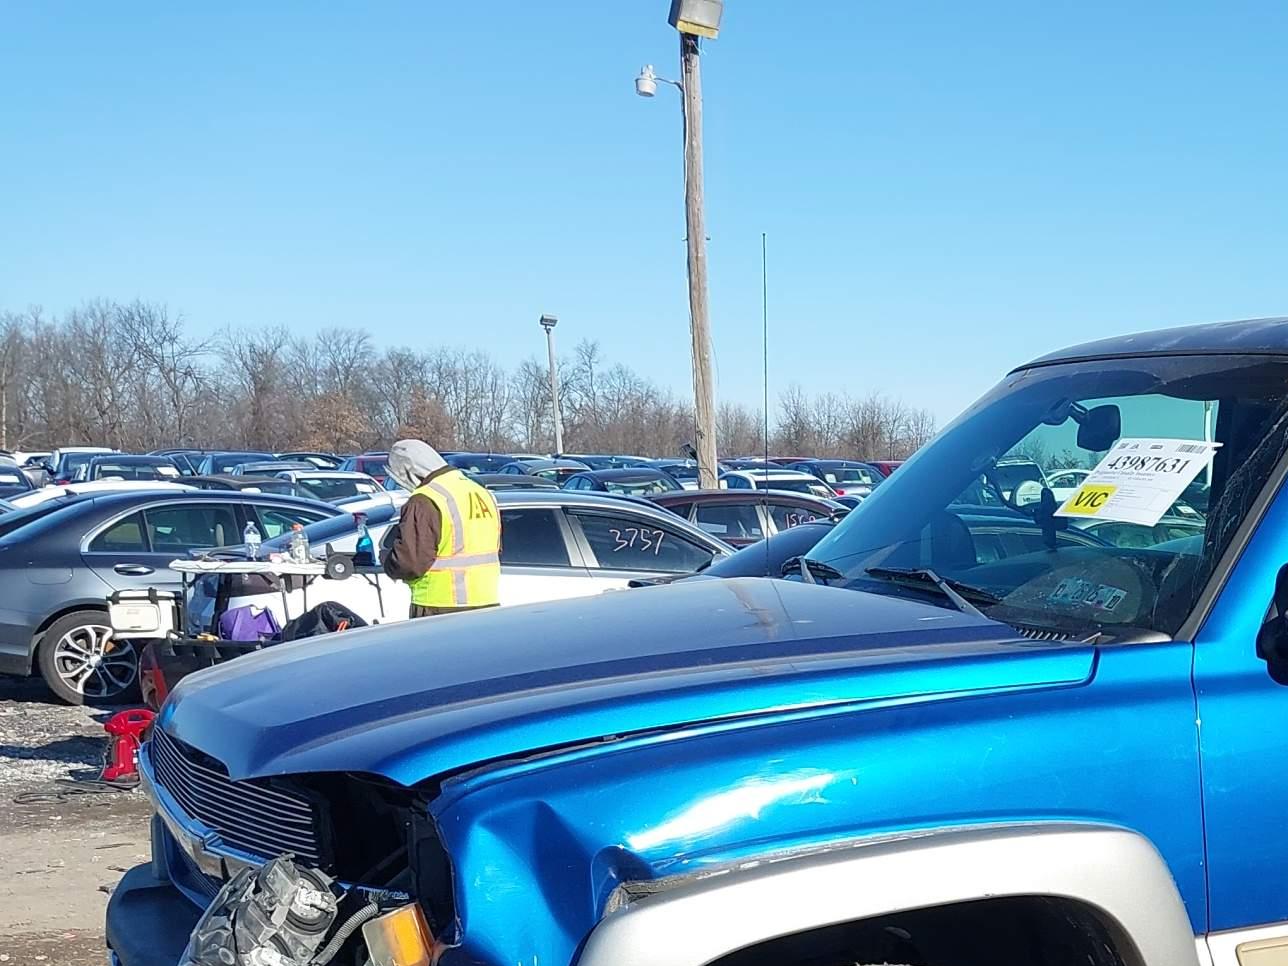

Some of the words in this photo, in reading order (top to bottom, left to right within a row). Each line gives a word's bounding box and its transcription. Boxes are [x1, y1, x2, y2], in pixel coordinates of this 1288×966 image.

[1107, 455, 1191, 474] 43987631
[1074, 491, 1109, 508] VIC
[609, 528, 665, 555] 3757
